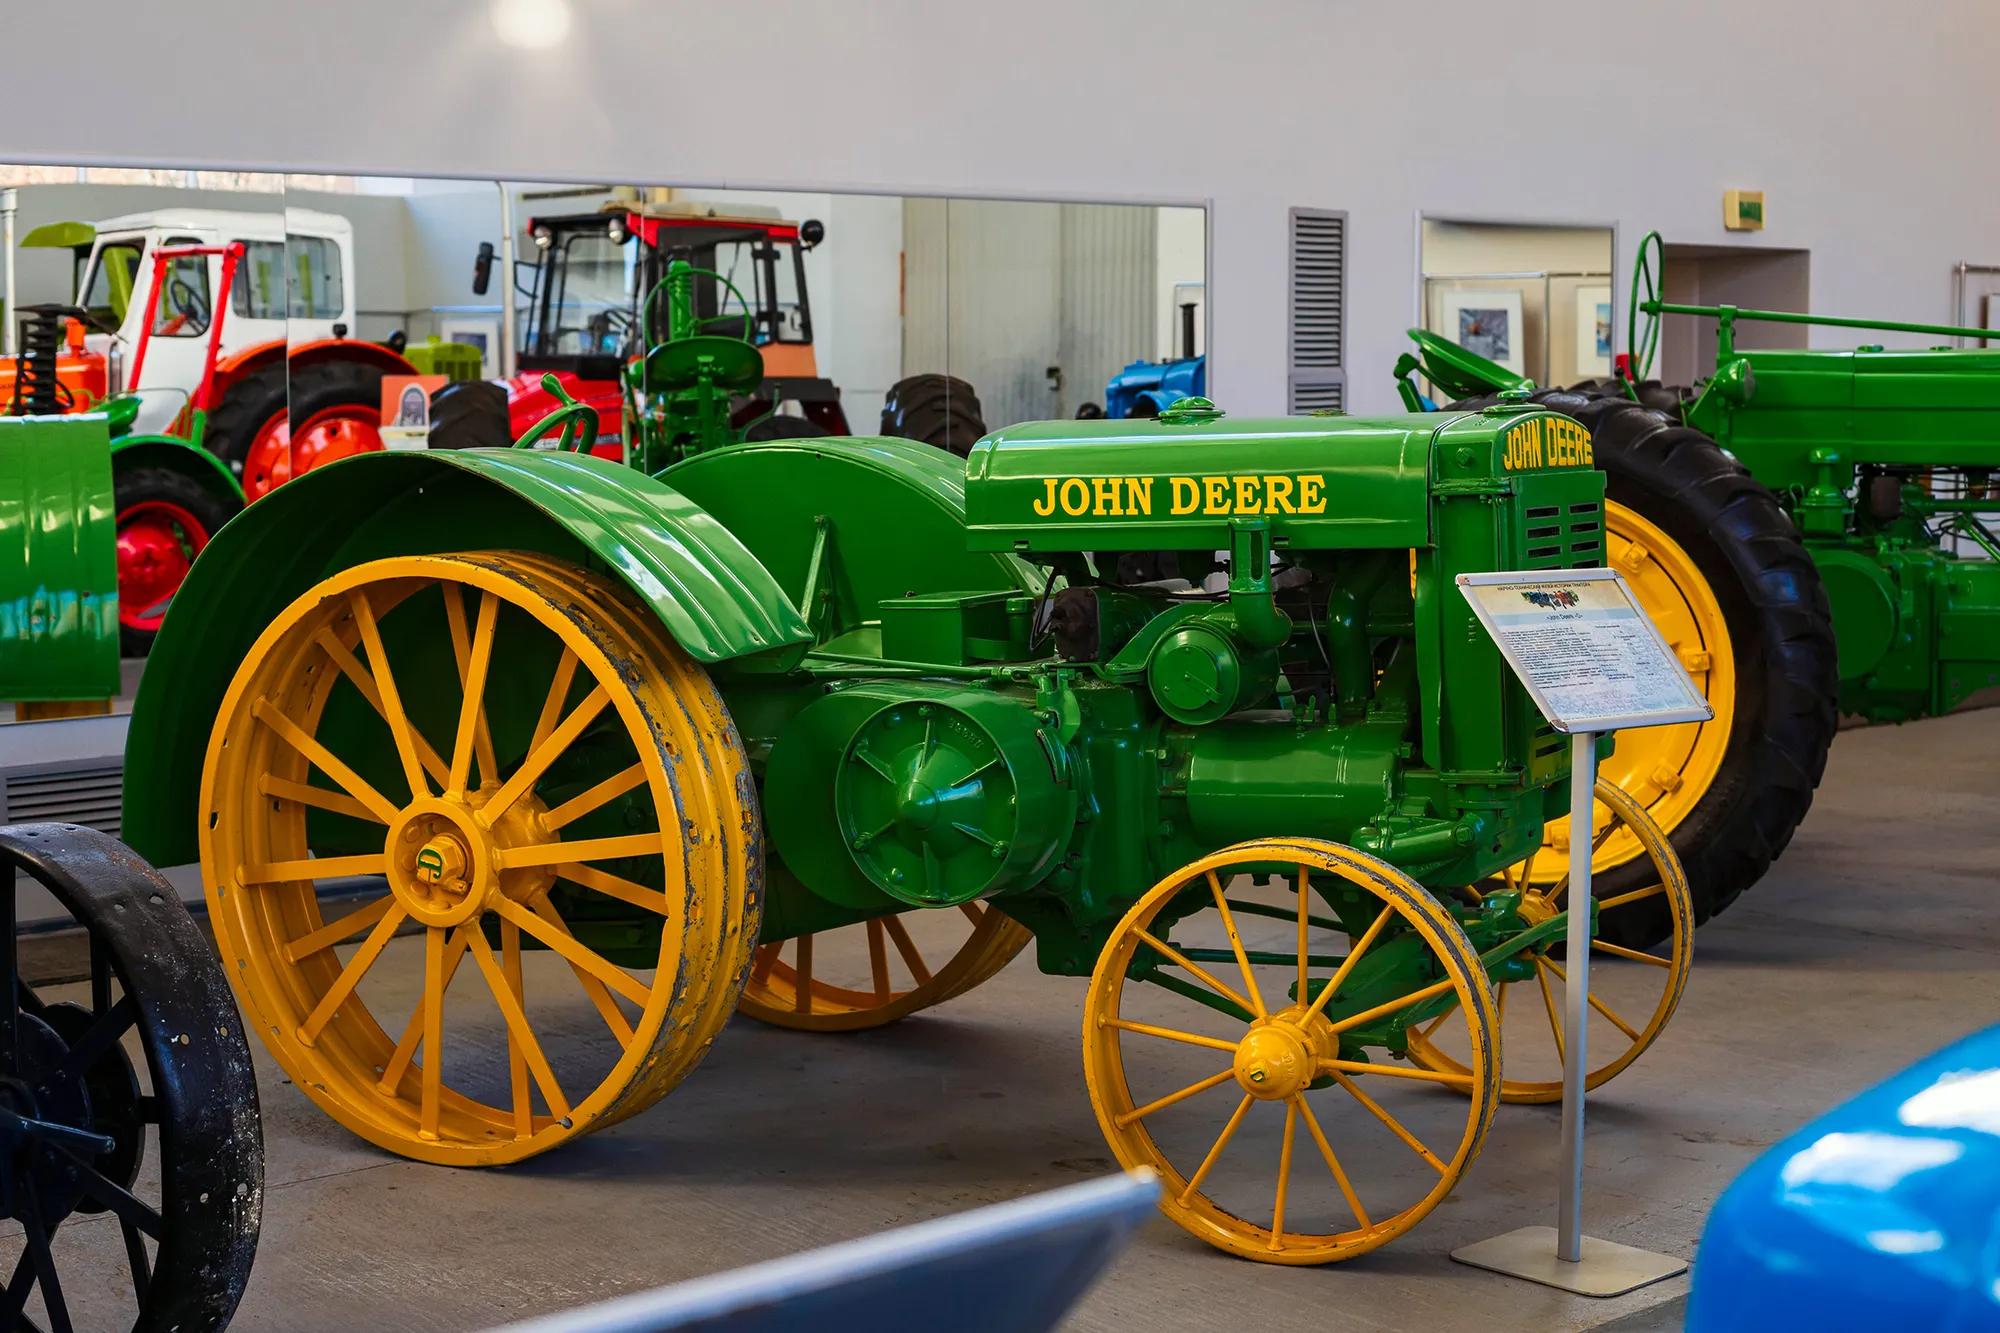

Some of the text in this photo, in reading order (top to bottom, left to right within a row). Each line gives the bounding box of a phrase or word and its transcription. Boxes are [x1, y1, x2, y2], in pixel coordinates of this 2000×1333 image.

[1503, 417, 1593, 470] JOHN DEERE
[1033, 474, 1327, 516] JOHN DEERE
